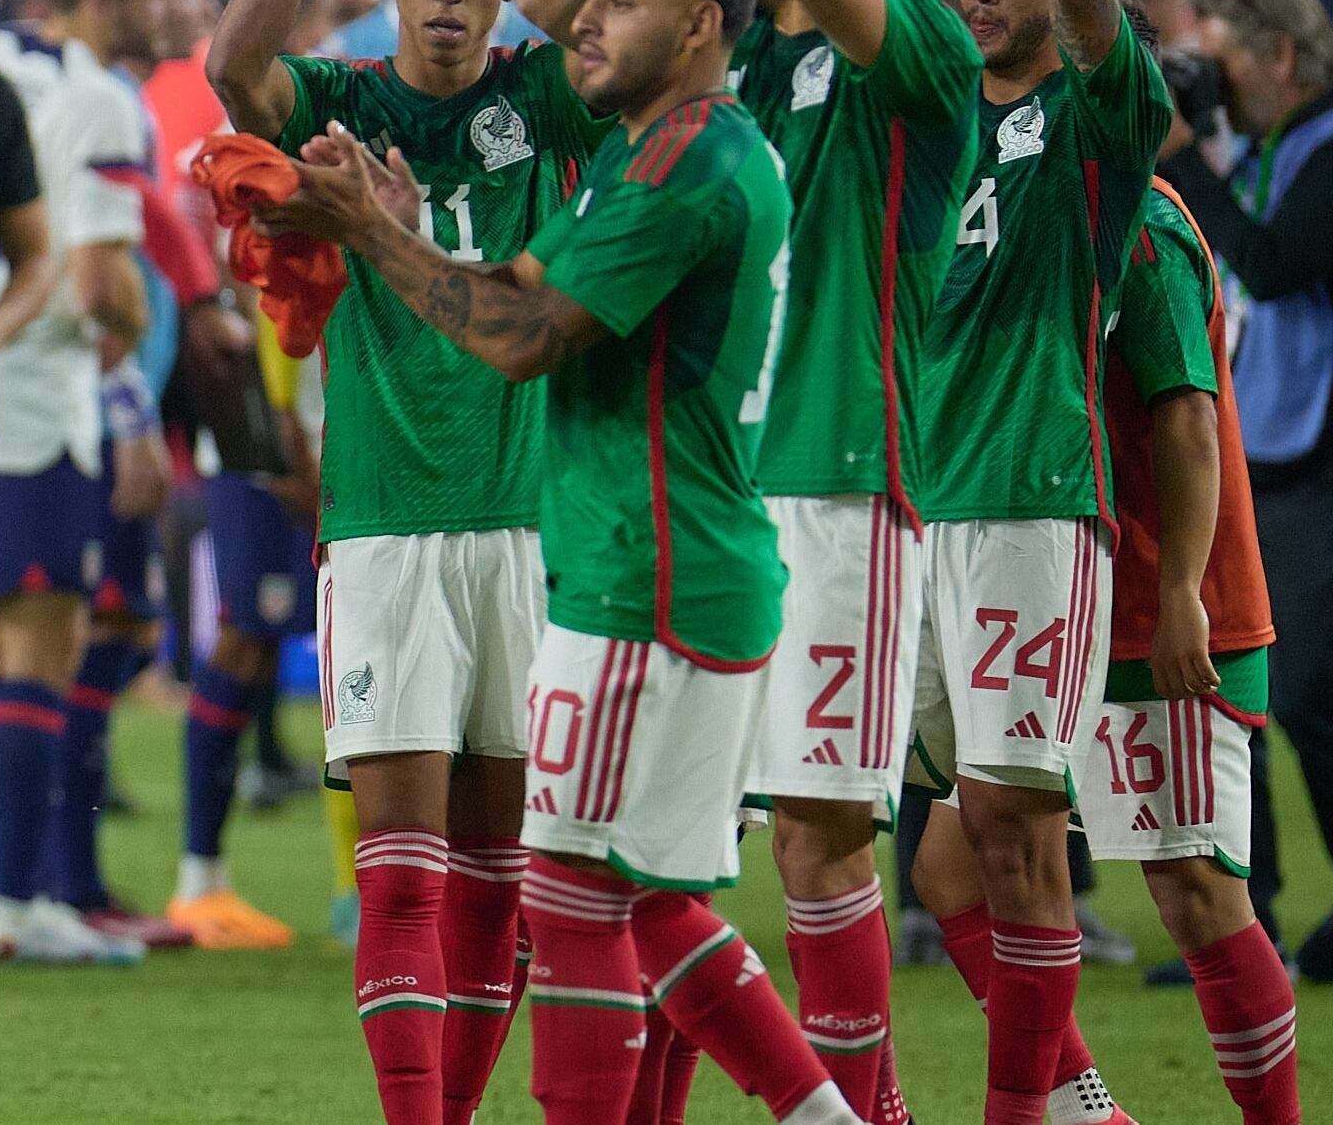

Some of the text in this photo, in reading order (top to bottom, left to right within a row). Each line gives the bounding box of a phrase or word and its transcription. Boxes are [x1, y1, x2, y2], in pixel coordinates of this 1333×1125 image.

[1002, 143, 1043, 160] MÉXICO
[970, 607, 1068, 699] 24
[805, 644, 857, 729] 2
[1094, 712, 1166, 795] 16
[358, 974, 418, 998] MÉXICO
[806, 1013, 882, 1031] MÉXICO
